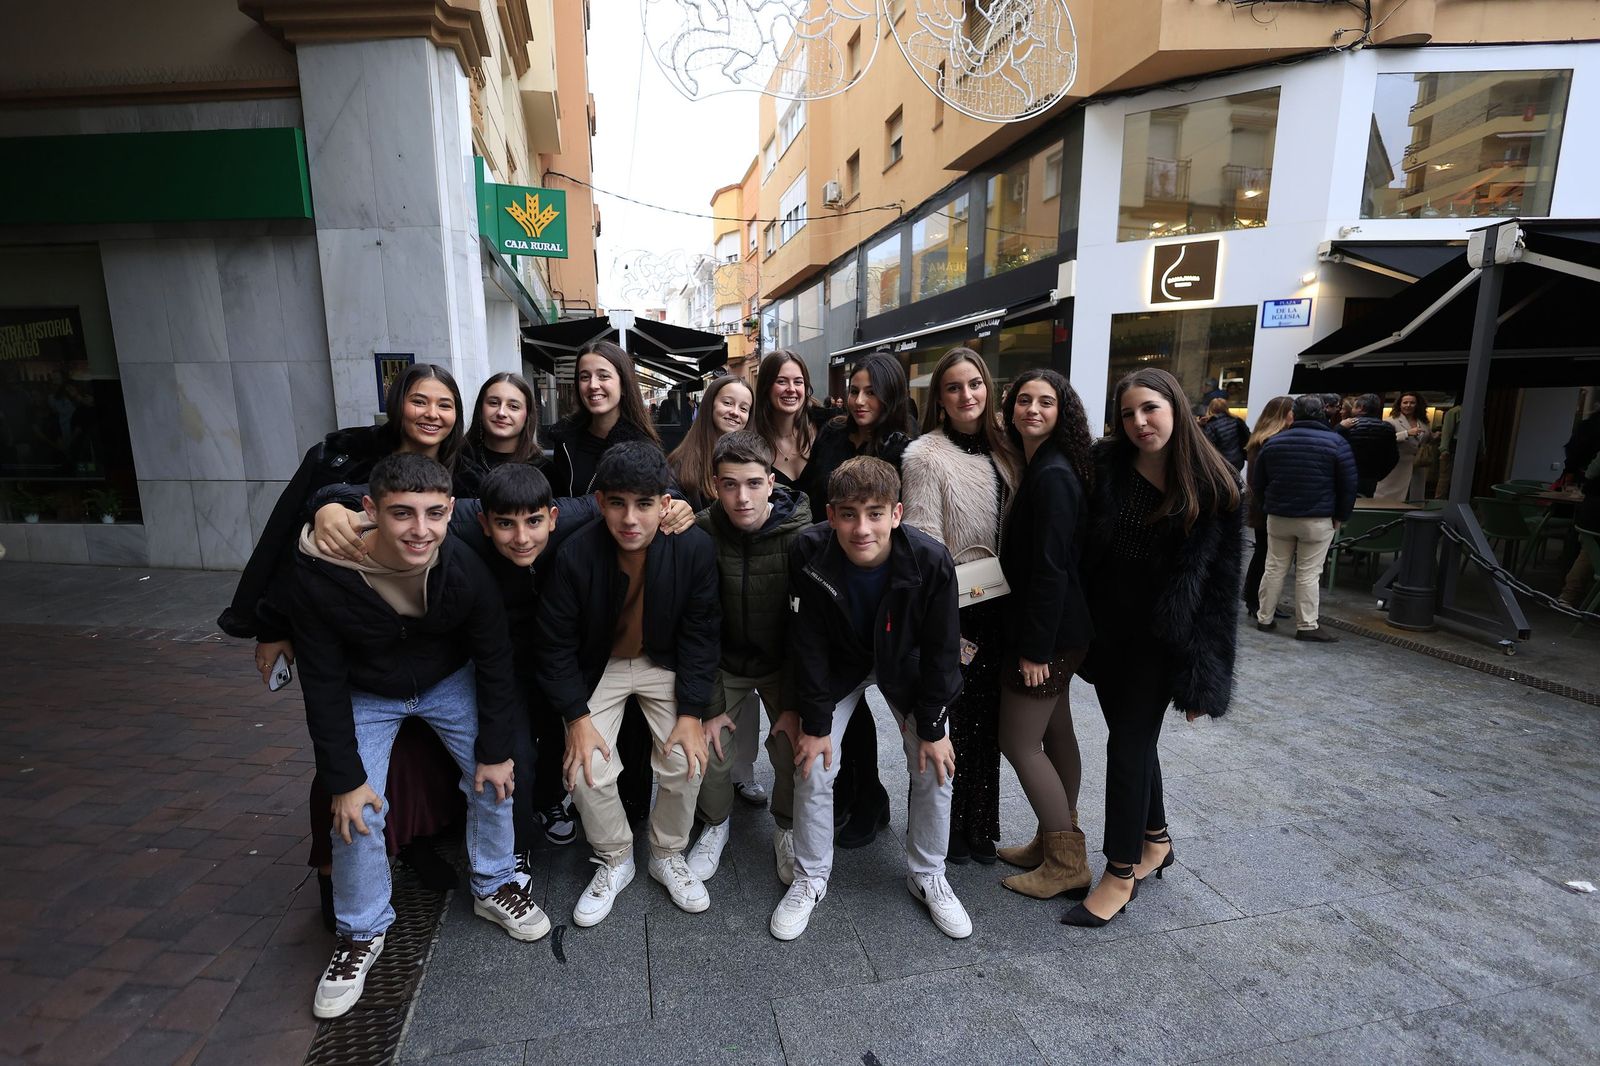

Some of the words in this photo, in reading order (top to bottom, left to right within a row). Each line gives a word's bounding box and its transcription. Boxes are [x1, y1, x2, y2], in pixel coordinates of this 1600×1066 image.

[504, 240, 528, 250] CAJA
[530, 241, 564, 252] RURAL
[1271, 313, 1301, 321] IGLESIA
[25, 317, 73, 340] HISTORIA
[810, 571, 824, 583] HELLY
[822, 580, 838, 597] HANSEN
